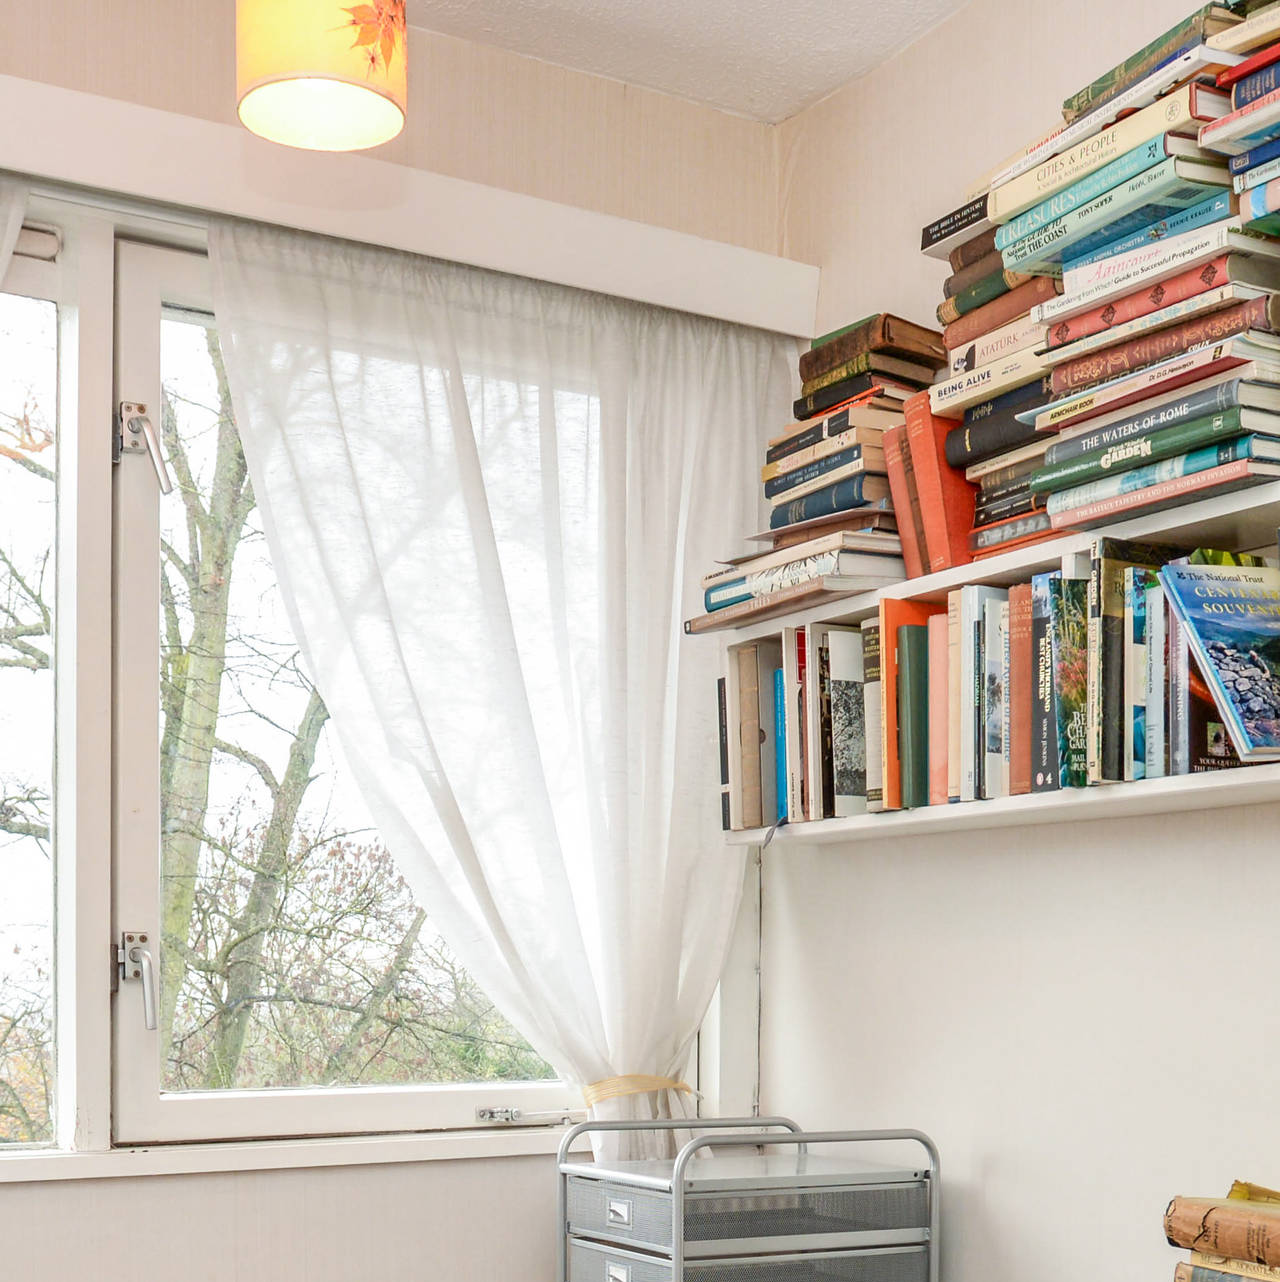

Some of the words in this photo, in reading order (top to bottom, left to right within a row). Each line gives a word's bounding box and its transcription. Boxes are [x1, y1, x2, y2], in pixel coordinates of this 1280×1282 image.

[1037, 160, 1065, 181] CITIES
[1069, 156, 1076, 165] &
[1080, 131, 1117, 159] PEOPLE
[1000, 191, 1075, 244] TREASURES
[1077, 206, 1094, 219] TONY
[1093, 195, 1113, 210] SOPER
[1028, 240, 1043, 253] THE
[1044, 224, 1069, 245] COAST
[1094, 250, 1113, 262] ANIMAL
[1113, 236, 1145, 254] ORCHESTRA
[1170, 215, 1189, 229] BERNIE
[1191, 206, 1212, 218] KRAUSE
[1047, 302, 1058, 313] The
[1058, 292, 1081, 310] Gardening
[1082, 287, 1094, 298] from
[1114, 271, 1132, 285] Guide
[1133, 269, 1140, 277] to
[1140, 254, 1171, 274] Successful
[1172, 240, 1210, 261] Propagation
[980, 333, 1018, 358] ATATÜRK
[1168, 360, 1194, 374] Hessayon
[937, 382, 964, 398] BEING
[966, 370, 992, 387] ALIVE
[1050, 403, 1078, 420] ARMCHAIR
[1079, 398, 1094, 409] BOOK
[1081, 435, 1099, 450] THE
[1102, 421, 1139, 443] WATERS
[1142, 416, 1156, 429] OF
[1160, 404, 1190, 422] ROME
[1100, 440, 1152, 468] GARDEN
[1077, 509, 1087, 518] THE
[1089, 501, 1114, 515] BAYEUX
[1115, 493, 1145, 508] TAPESTRY
[1145, 488, 1160, 500] AND
[1163, 485, 1176, 495] THE
[1176, 475, 1206, 490] NORMAN
[1207, 464, 1242, 481] INVASION
[1187, 573, 1205, 582] The
[1207, 573, 1241, 584] National
[1243, 575, 1264, 585] Trust
[1002, 667, 1011, 704] Rivers
[1003, 718, 1011, 762] France
